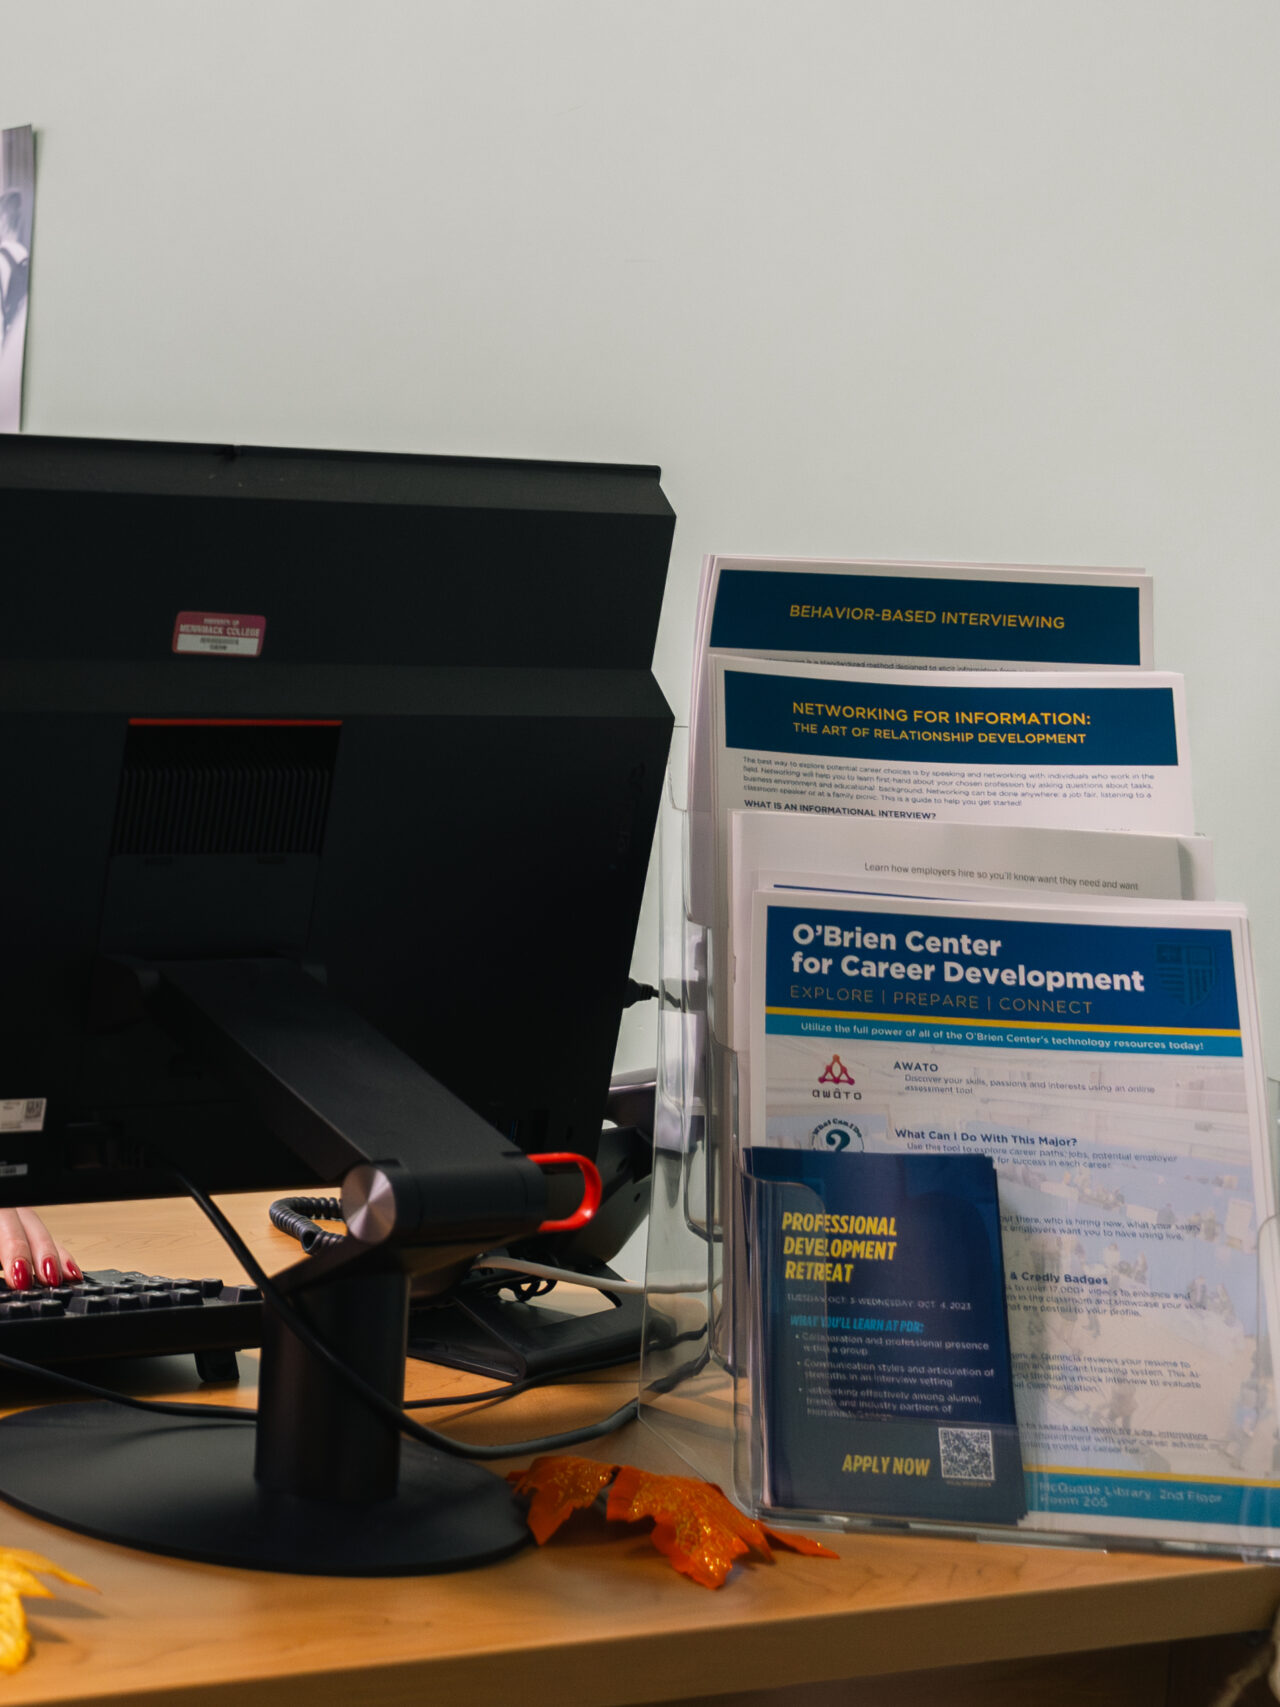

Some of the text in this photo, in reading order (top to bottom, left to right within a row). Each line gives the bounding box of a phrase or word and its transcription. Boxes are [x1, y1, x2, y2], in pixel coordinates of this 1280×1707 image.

[790, 605, 1065, 629] BEHAVIOR-BASED INTERVIEWING
[793, 702, 1091, 725] NETWORKING FOR INFORMATION:
[793, 722, 1086, 744] THE ART OF RELATIONSHIP DEVELOPMENT
[799, 761, 824, 771] explore
[826, 763, 857, 773] potential
[921, 768, 929, 777] by
[932, 769, 965, 778] speaking
[984, 771, 1026, 780] networking
[911, 795, 932, 804] guide
[944, 797, 960, 805] help
[744, 800, 771, 809] WHAT
[784, 803, 797, 811] AN
[799, 804, 876, 816] INFORMATIONAL
[879, 809, 936, 820] INTERVIEW?
[864, 863, 889, 872] Learn
[891, 864, 909, 874] how
[911, 866, 956, 879] employers
[958, 869, 974, 878] hire
[990, 871, 1012, 882] you'll
[1013, 873, 1035, 882] know
[1038, 875, 1057, 884] want
[1059, 876, 1076, 887] they
[1079, 877, 1100, 887] need
[1102, 879, 1117, 888] and
[1119, 880, 1139, 889] want
[793, 924, 1001, 957] O'Brien Center
[792, 952, 1145, 996] for Career Development
[790, 986, 1093, 1015] EXPLORE PREPARE CONNECT
[801, 1021, 1204, 1052] Utilize the full power of all of the O'Brien Center's technology resources today!
[894, 1061, 938, 1072] AWATO
[905, 1075, 941, 1083] Discover
[943, 1078, 963, 1086] your
[990, 1080, 1026, 1090] passions
[1088, 1084, 1112, 1093] using
[832, 1118, 848, 1127] Can
[895, 1130, 1077, 1147] What Can I Do With This Major?
[974, 1146, 1007, 1156] explore
[1092, 1152, 1132, 1161] potential
[782, 1211, 897, 1236] PROFESSIONAL
[783, 1237, 897, 1261] DEVELOPMENT
[785, 1261, 854, 1283] RETREAT
[1022, 1272, 1060, 1284] Credly
[1064, 1274, 1108, 1286] Badges
[790, 1314, 820, 1327] WHAT
[853, 1317, 884, 1330] LEARN
[885, 1319, 899, 1331] AT
[840, 1347, 868, 1356] group
[865, 1336, 989, 1352] and professional presence
[877, 1364, 994, 1377] styles and articulation of
[842, 1454, 931, 1477] APPLY NOW
[1160, 1489, 1184, 1501] 2nd
